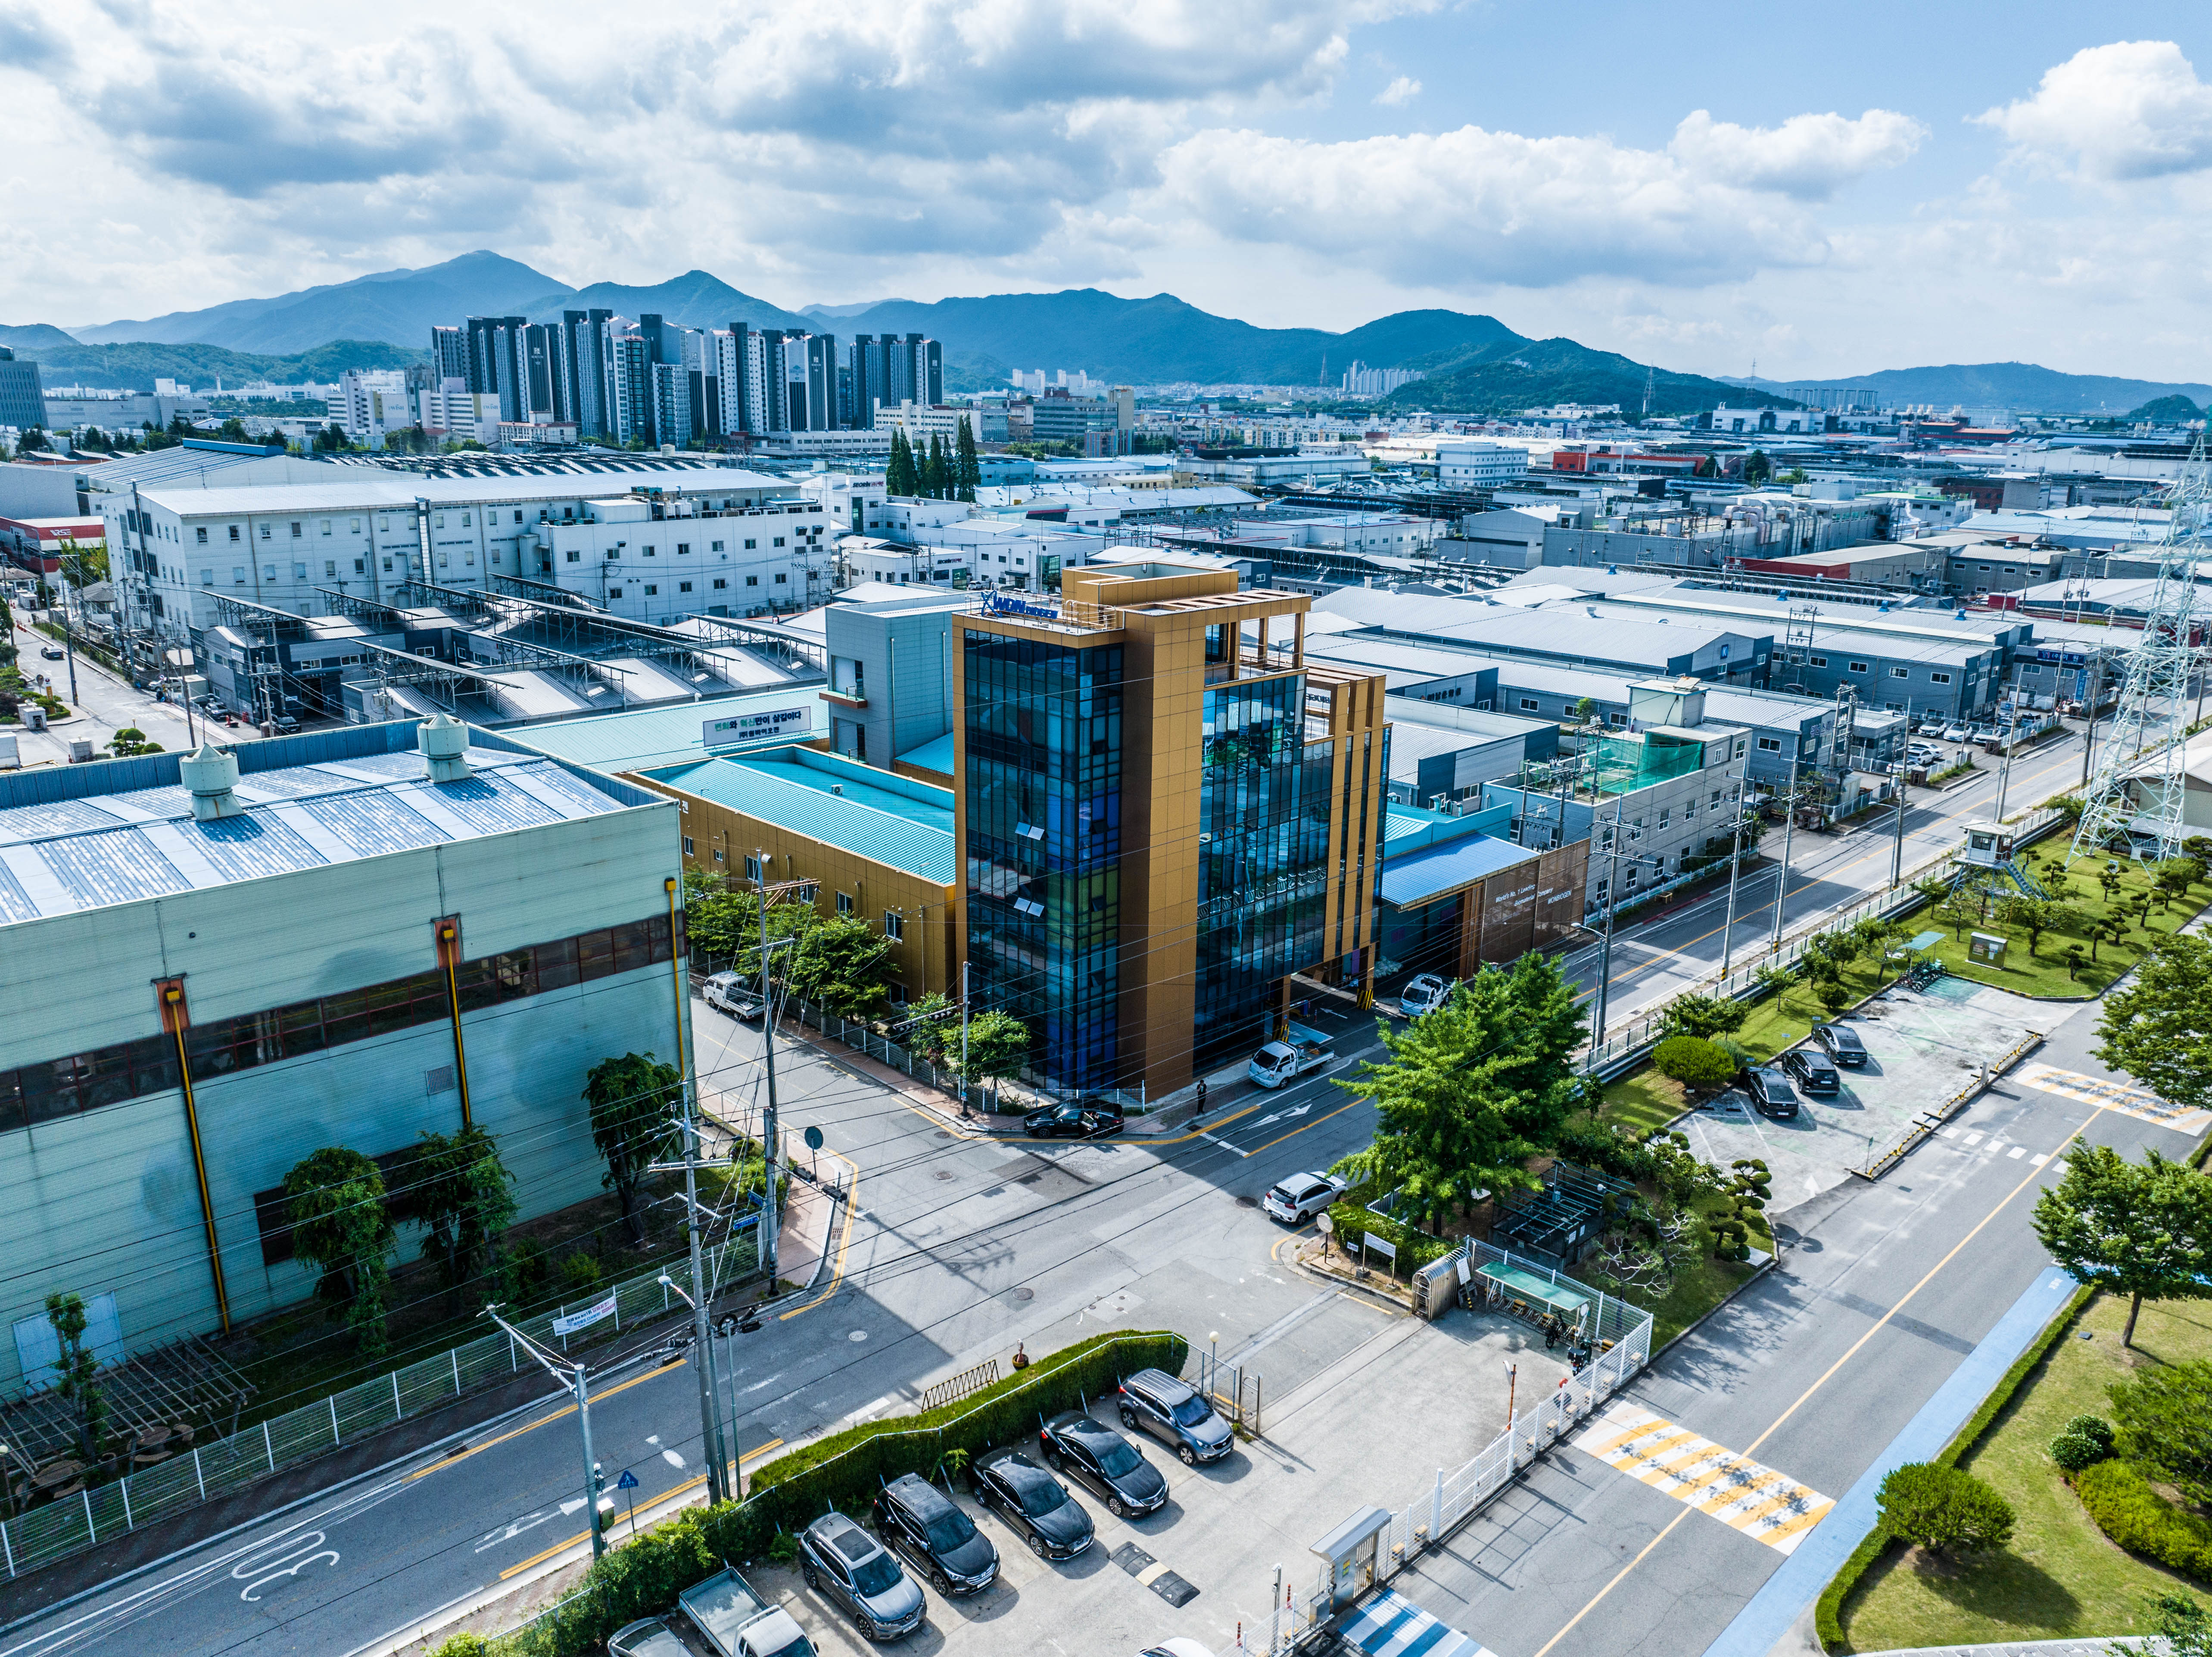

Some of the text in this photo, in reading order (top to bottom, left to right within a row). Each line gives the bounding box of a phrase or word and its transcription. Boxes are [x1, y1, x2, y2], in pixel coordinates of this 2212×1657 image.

[715, 711, 802, 732] 변화와 혁신만이 살길이다
[1495, 893, 1510, 903] World's
[1521, 884, 1536, 894] Leading
[1548, 889, 1572, 905] WONBIOGEN
